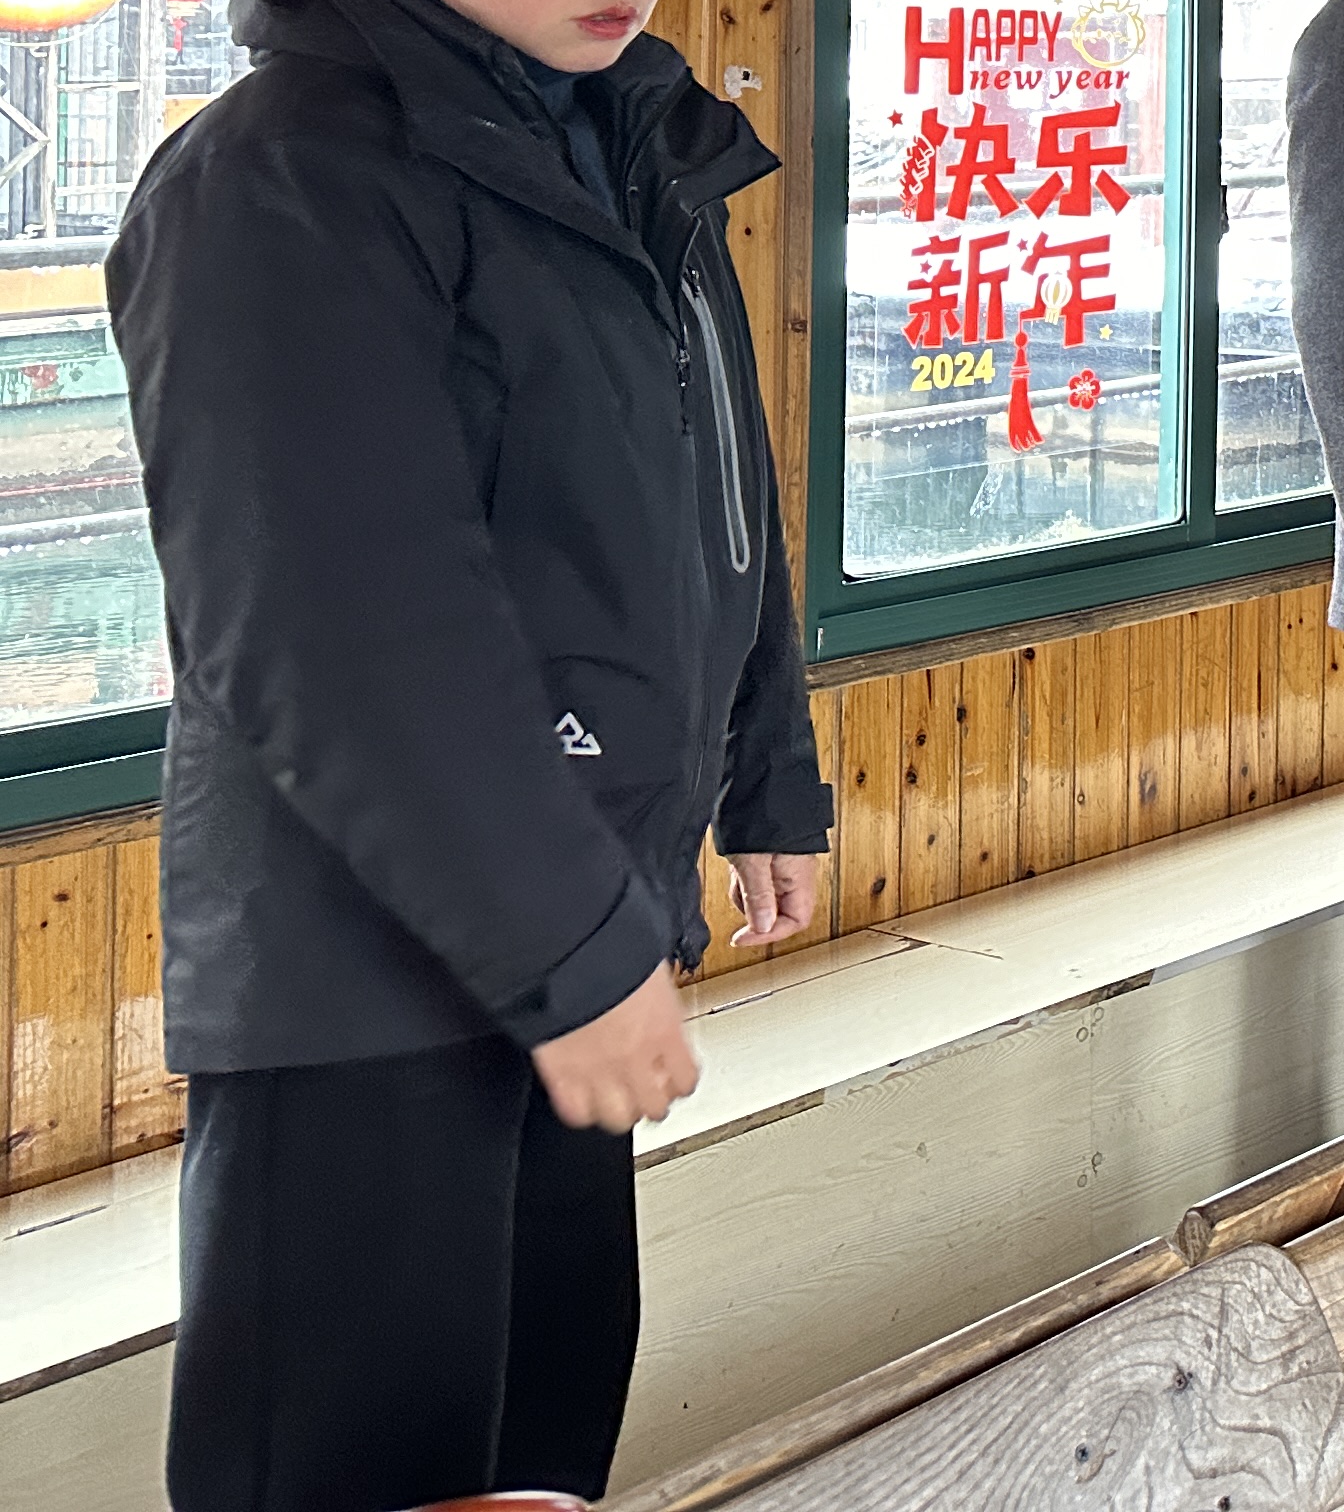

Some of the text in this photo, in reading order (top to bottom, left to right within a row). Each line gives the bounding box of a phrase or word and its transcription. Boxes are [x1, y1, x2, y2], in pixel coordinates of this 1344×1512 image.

[903, 4, 1064, 96] HAPPY
[970, 68, 1131, 99] new year
[901, 101, 1131, 223] 快乐
[903, 230, 1118, 348] 新年
[910, 348, 996, 393] 2024
